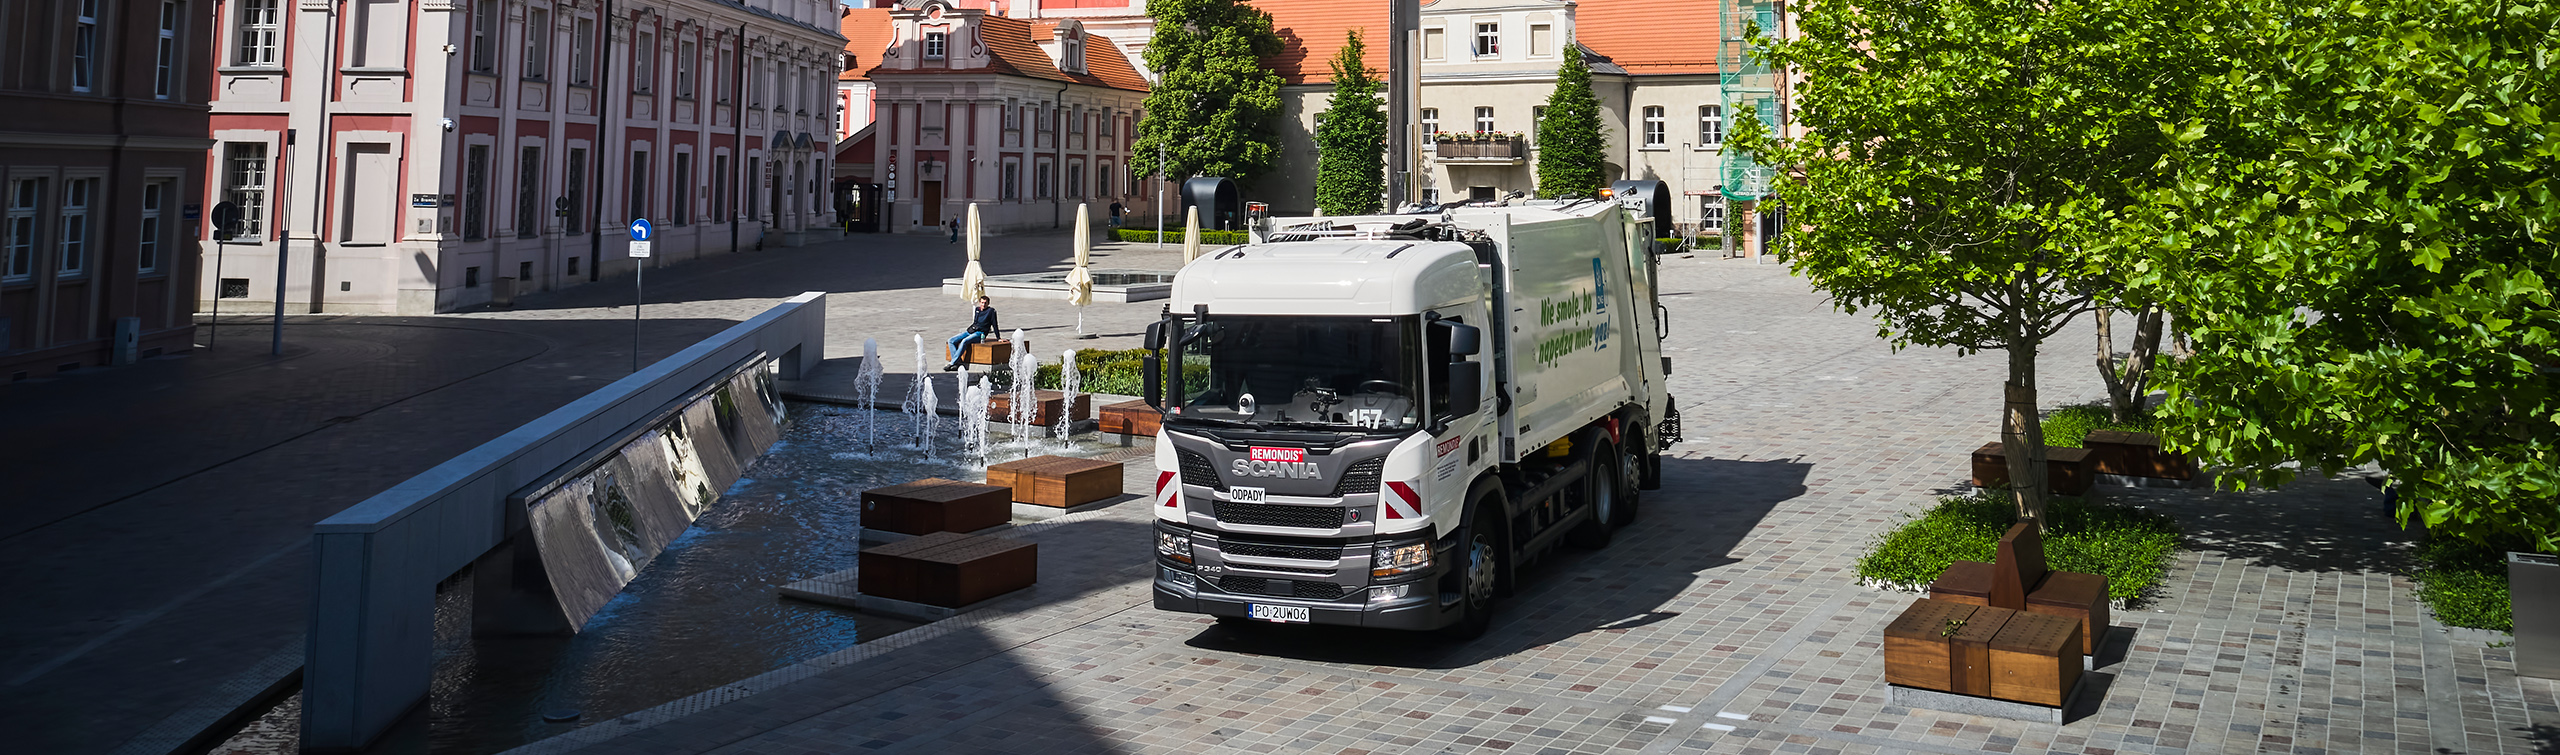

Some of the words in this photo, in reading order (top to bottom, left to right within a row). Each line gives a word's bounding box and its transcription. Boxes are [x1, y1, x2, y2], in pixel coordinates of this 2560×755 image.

[1541, 297, 1554, 327] Nie
[1556, 291, 1581, 326] smolę,
[1583, 287, 1592, 314] bo
[1539, 328, 1573, 368] napędza
[1575, 320, 1592, 350] mnie
[1594, 313, 1610, 352] gaz!
[1349, 409, 1382, 429] 157
[1251, 448, 1299, 461] REMONDIS
[1231, 458, 1323, 480] SCANIA
[1231, 488, 1263, 502] ODPADY
[1255, 605, 1269, 617] PO
[1273, 606, 1307, 620] 2UW06
